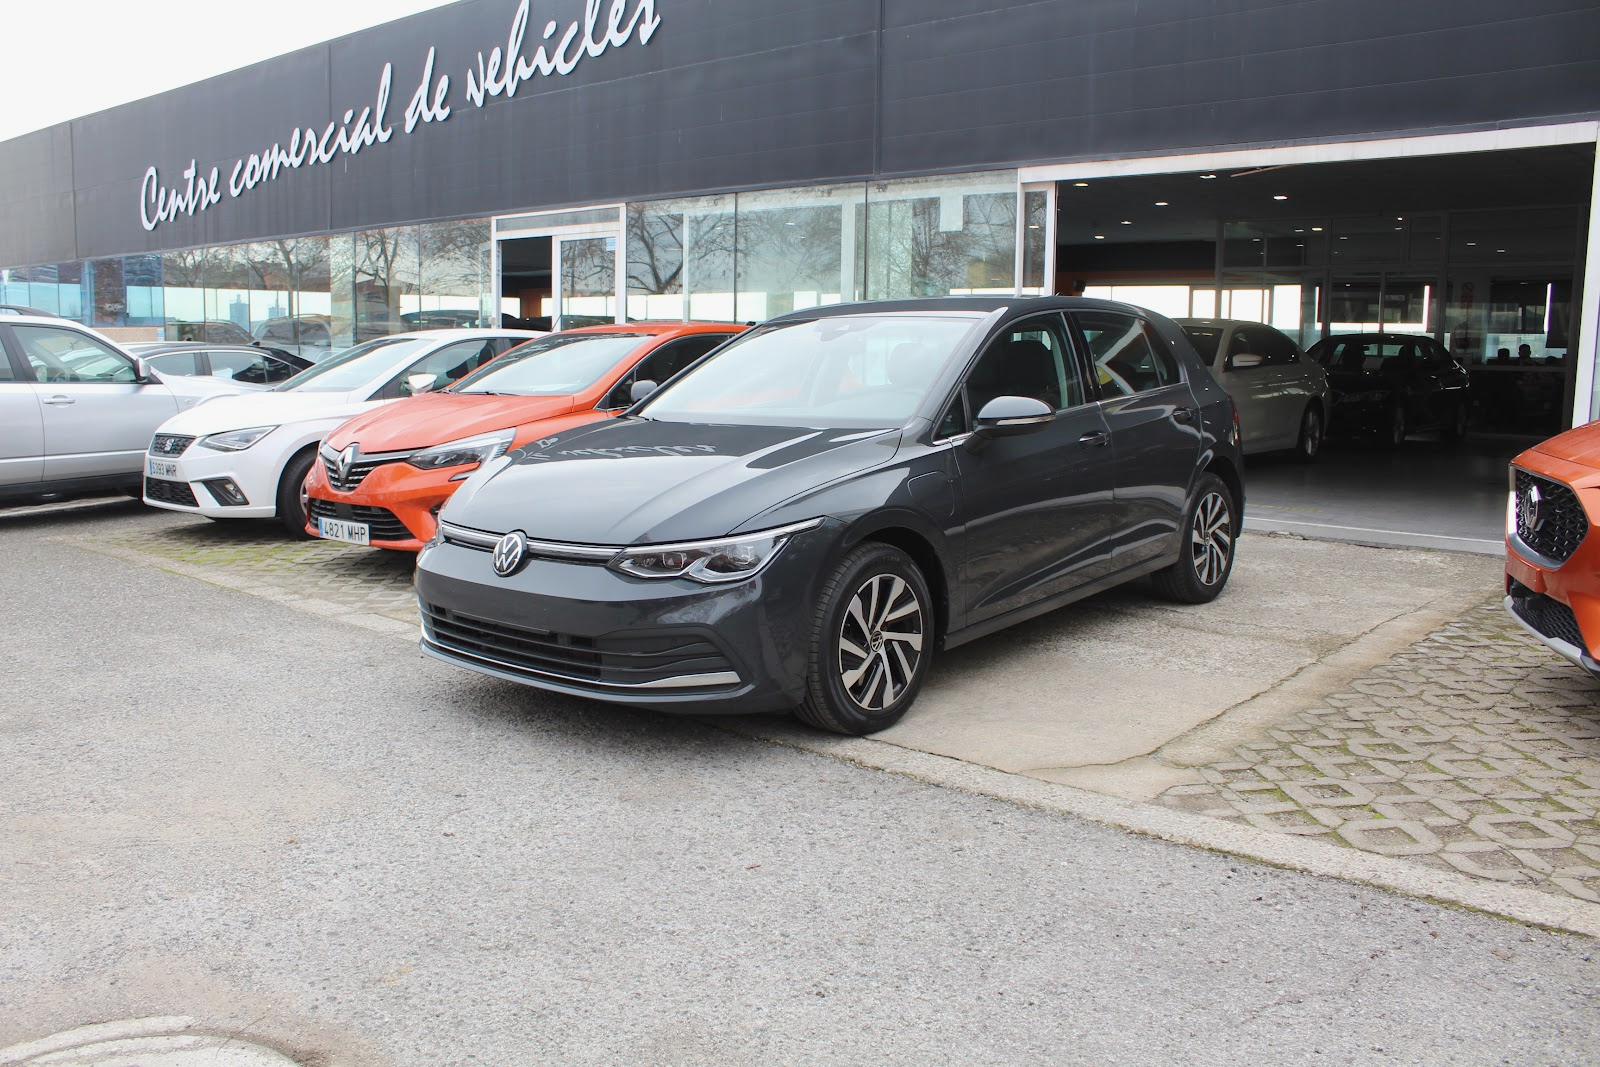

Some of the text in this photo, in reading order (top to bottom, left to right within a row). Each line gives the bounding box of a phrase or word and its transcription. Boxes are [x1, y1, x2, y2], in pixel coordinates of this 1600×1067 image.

[140, 0, 661, 231] Centre comercial de vehicles
[324, 521, 366, 542] 4821 MHP
